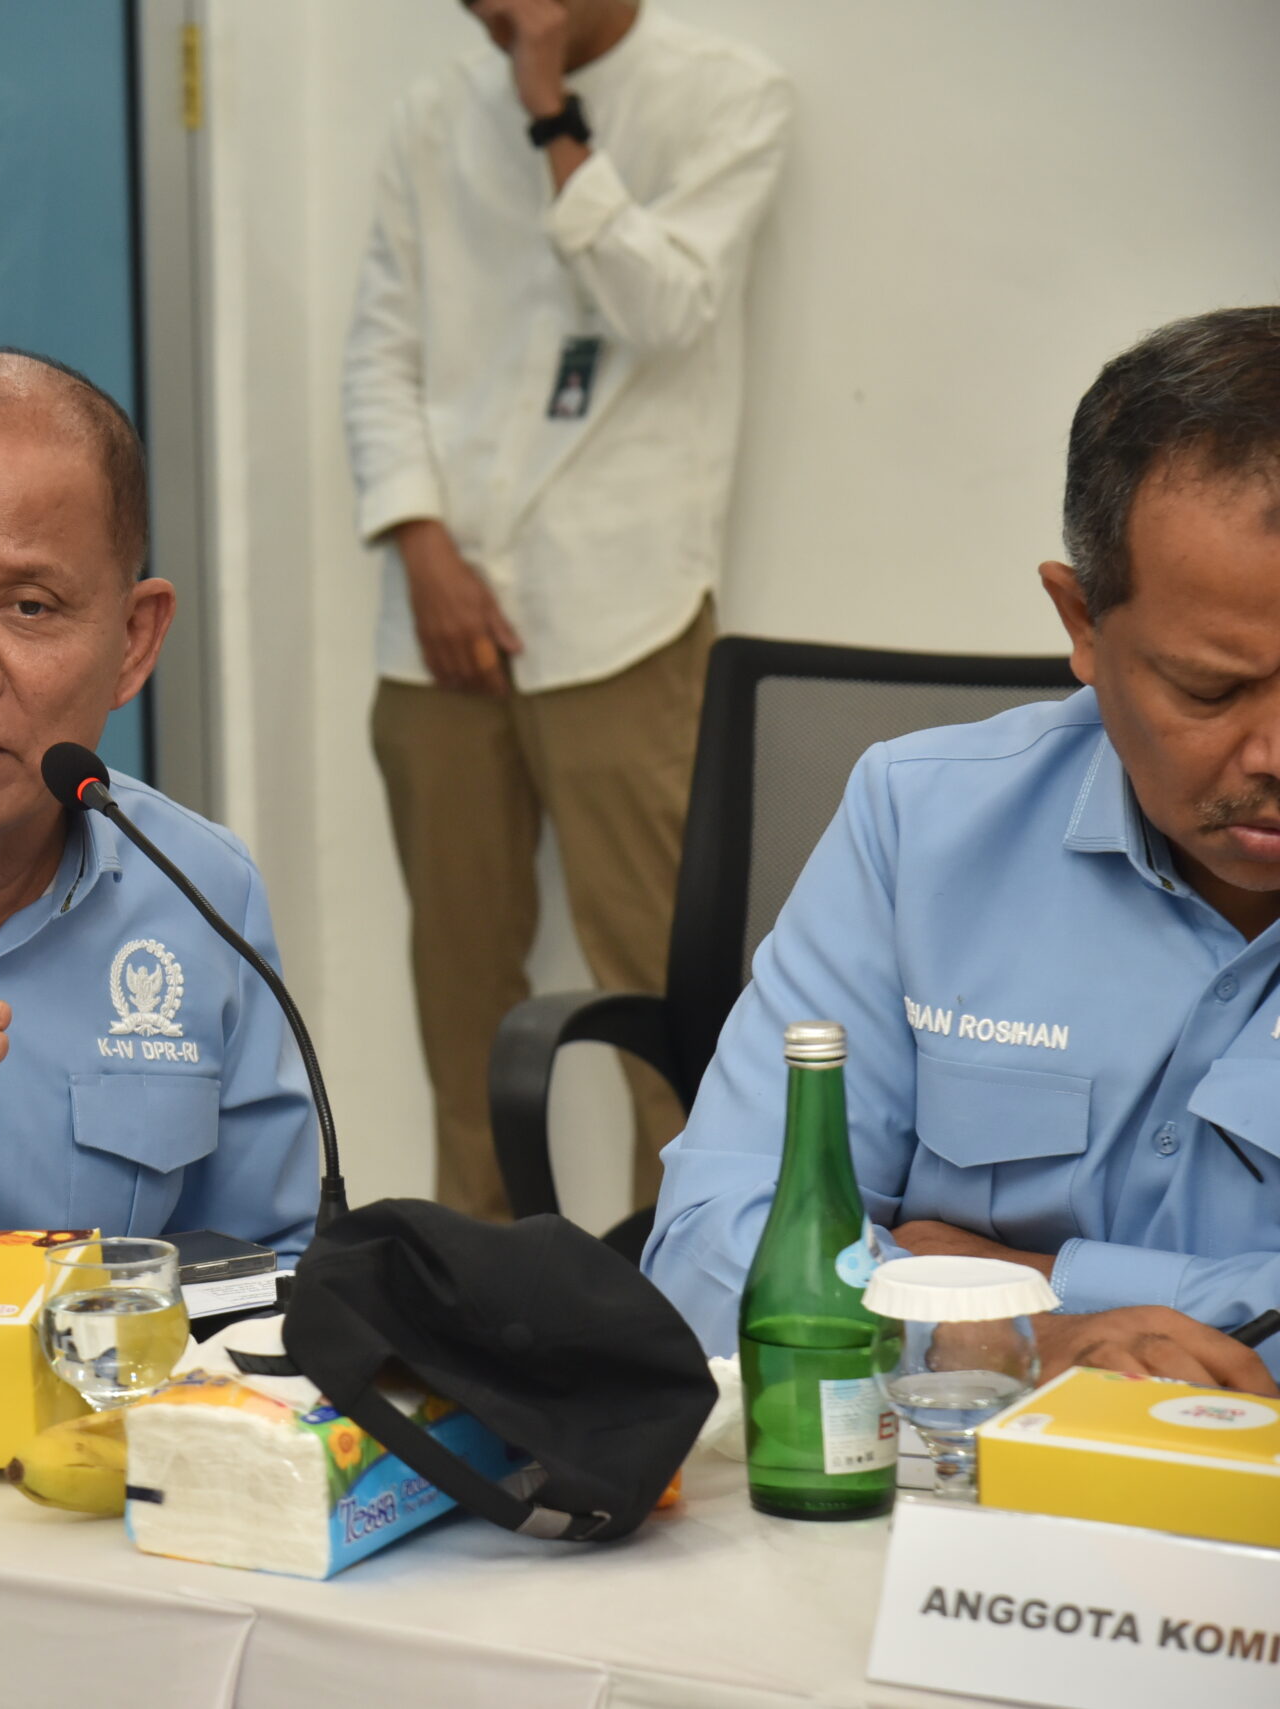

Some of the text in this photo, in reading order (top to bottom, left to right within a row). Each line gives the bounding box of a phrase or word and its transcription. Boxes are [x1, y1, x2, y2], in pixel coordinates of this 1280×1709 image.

[96, 1037, 199, 1063] K-IV DPR-RI
[958, 1013, 1069, 1050] ROSIHAN
[920, 1585, 1141, 1645] ANGGOTA
